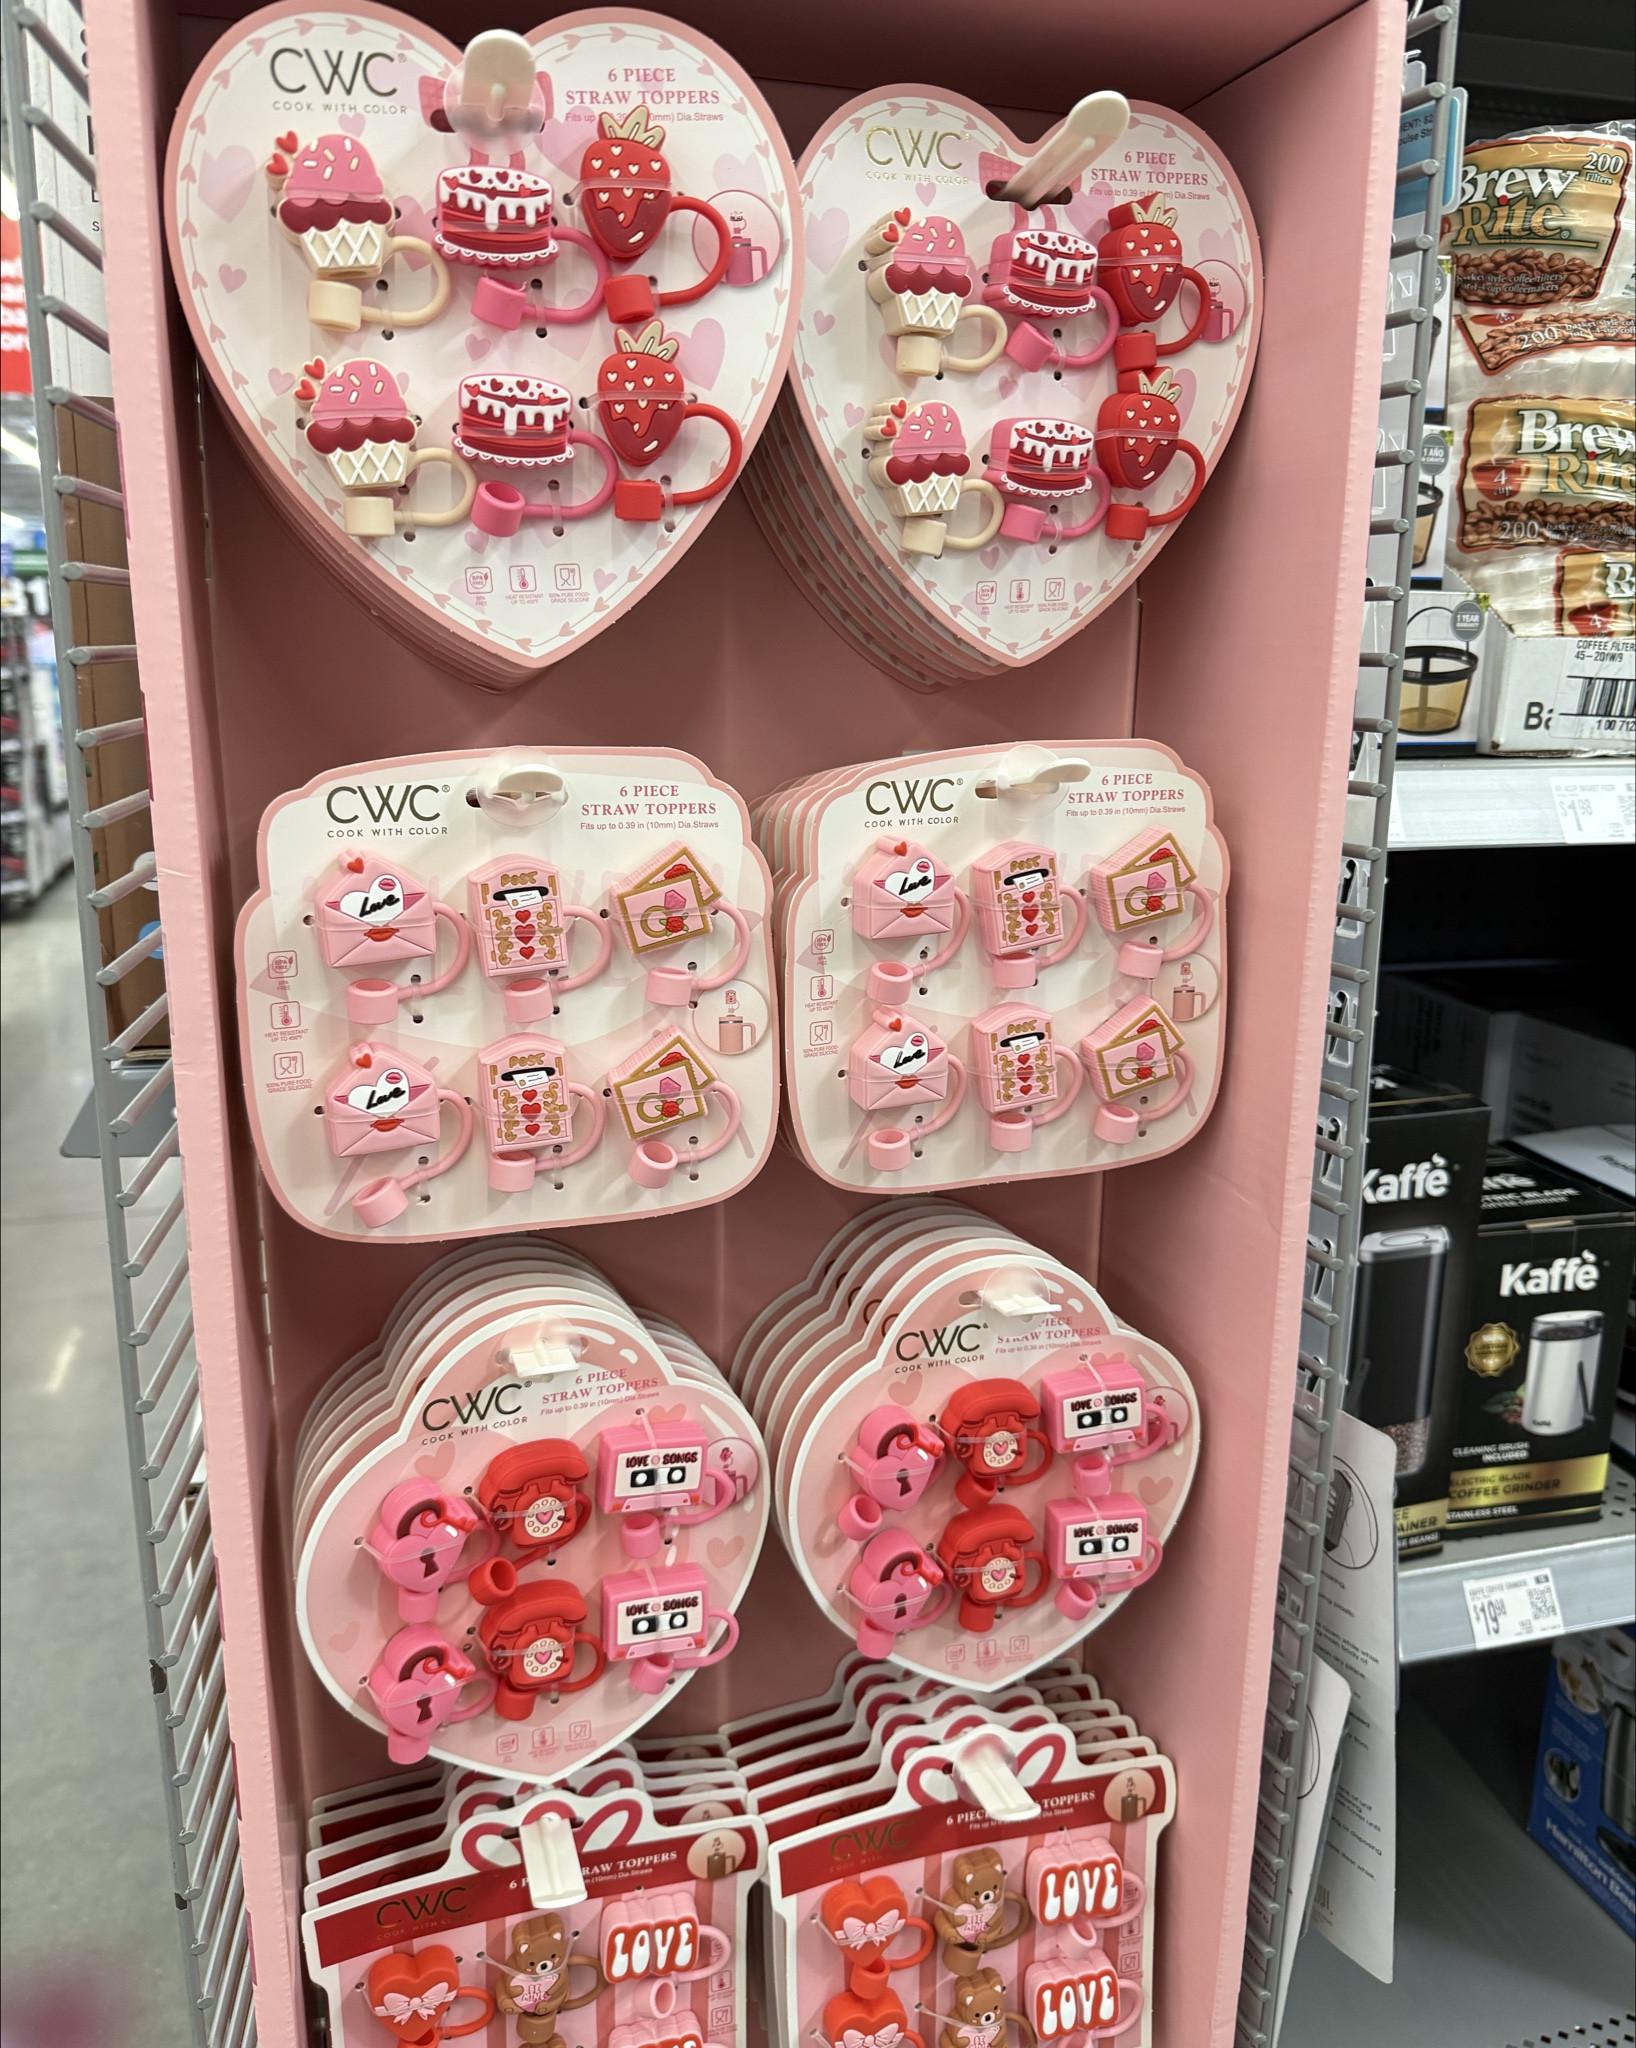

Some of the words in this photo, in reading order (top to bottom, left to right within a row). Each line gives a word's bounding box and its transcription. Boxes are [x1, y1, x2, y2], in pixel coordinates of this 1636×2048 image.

[608, 68, 617, 82] 6
[624, 68, 676, 82] PIECE
[566, 90, 631, 104] STRAW
[638, 90, 720, 104] TOPPERS
[272, 101, 314, 111] COOK
[323, 103, 357, 112] WITH
[364, 104, 407, 114] COLOR
[565, 113, 581, 122] Fits
[584, 114, 595, 123] up
[1124, 151, 1132, 162] 6
[1136, 152, 1176, 165] PIECE
[1583, 152, 1624, 174] 200
[866, 171, 896, 180] COOK
[904, 173, 930, 182] WITH
[936, 175, 969, 185] COLOR
[1091, 168, 1142, 182] STRAW
[1146, 171, 1208, 186] TOPPERS
[1460, 164, 1580, 204] Brew
[1585, 172, 1614, 186] Filters
[1090, 187, 1102, 195] Fits
[1104, 188, 1112, 197] up
[1114, 188, 1122, 196] to
[1452, 194, 1565, 246] Rite
[1518, 326, 1560, 349] 200
[1423, 448, 1428, 457] 1
[1428, 446, 1444, 458] AÑO
[1493, 468, 1508, 485] 4
[1493, 485, 1513, 496] cup
[1499, 520, 1540, 540] 200
[1456, 614, 1461, 622] 1
[1462, 614, 1480, 622] YEAR
[1589, 614, 1602, 629] 4
[1576, 640, 1608, 650] COFFEE
[1102, 776, 1109, 786] 6
[1114, 774, 1153, 786] PIECE
[620, 786, 628, 797] 6
[634, 785, 680, 797] PIECE
[1068, 792, 1118, 804] STRAW
[1122, 789, 1184, 802] TOPPERS
[581, 804, 640, 816] STRAW
[645, 802, 716, 815] TOPPERS
[1080, 810, 1088, 818] up
[1098, 808, 1114, 816] 0.39
[1122, 807, 1148, 816] (10mm)
[580, 822, 594, 830] Fits
[597, 823, 606, 832] up
[608, 822, 616, 830] to
[618, 822, 636, 830] 0.39
[646, 821, 676, 830] (10mm)
[864, 820, 893, 828] COOK
[899, 818, 923, 826] WITH
[928, 816, 958, 824] COLOR
[327, 829, 364, 838] COOK
[372, 828, 403, 836] WITH
[408, 826, 448, 836] COLOR
[1010, 855, 1041, 872] POST
[500, 871, 538, 887] POST
[899, 876, 932, 895] Love
[359, 894, 400, 918] Love
[509, 1053, 546, 1068] POST
[894, 1050, 926, 1068] Love
[366, 1087, 406, 1110] Love
[1500, 1249, 1600, 1298] Kaffè
[1046, 1327, 1101, 1340] TOPPERS
[895, 1363, 922, 1374] COOK
[928, 1358, 951, 1369] WITH
[954, 1354, 984, 1364] COLOR
[576, 1376, 583, 1384] 6
[588, 1368, 628, 1382] PIECE
[542, 1388, 592, 1404] STRAW
[597, 1377, 658, 1396] TOPPERS
[1071, 1399, 1092, 1412] LOVE
[1104, 1392, 1138, 1406] SONGS
[422, 1432, 454, 1446] COOK
[460, 1424, 488, 1436] WITH
[493, 1416, 528, 1430] COLOR
[1453, 1444, 1497, 1458] CLEANING
[1498, 1441, 1530, 1451] BRUSH
[1482, 1450, 1529, 1464] INCLUDED
[626, 1454, 650, 1468] LOVE
[662, 1452, 698, 1465] SONGS
[1498, 1471, 1531, 1482] BLADE
[1450, 1485, 1499, 1498] COFFEE
[1502, 1478, 1560, 1495] GRINDER
[1498, 1505, 1518, 1515] STEEL
[1074, 1526, 1094, 1538] LOVE
[1106, 1523, 1138, 1536] SONGS
[626, 1602, 650, 1617] LOVE
[662, 1596, 699, 1612] SONGS
[946, 1816, 954, 1826] 6
[1043, 1790, 1096, 1808] TOPPERS
[582, 1862, 613, 1876] RAW
[616, 1850, 678, 1870] TOPPERS
[509, 1880, 517, 1889] 6
[1045, 1863, 1118, 1920] LOVE
[611, 1922, 692, 1978] LOVE
[1042, 1976, 1114, 2035] LOVE
